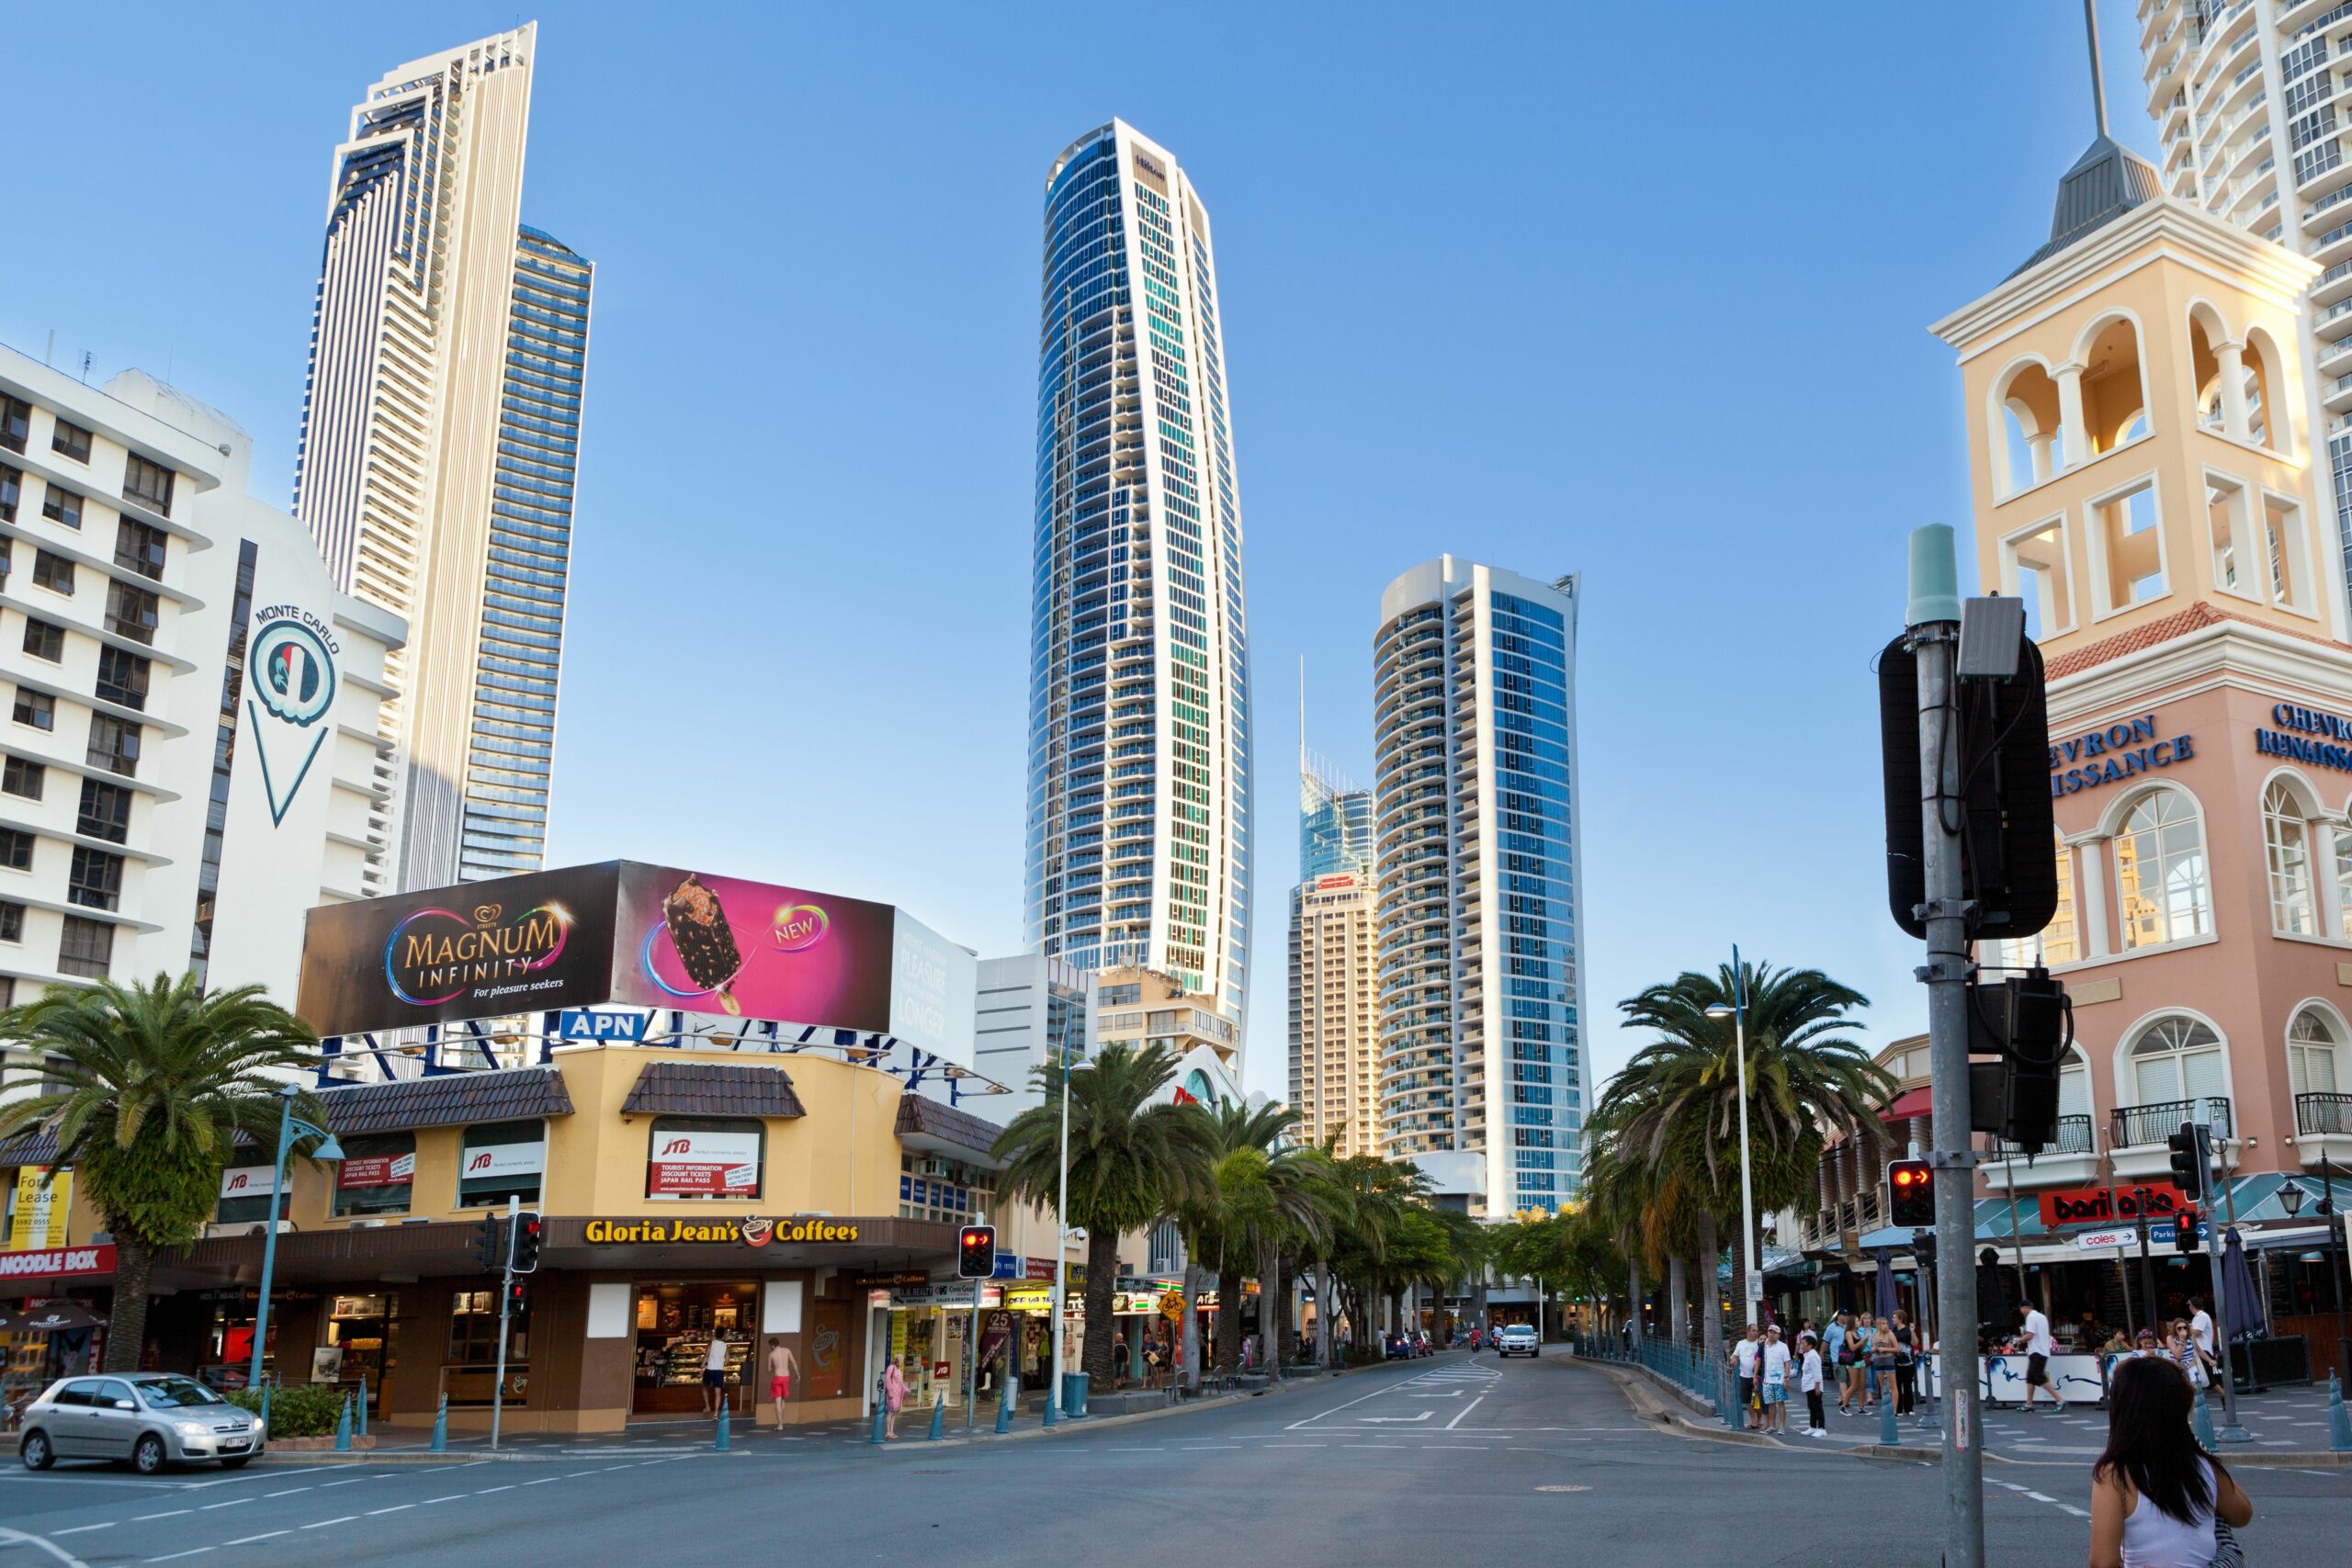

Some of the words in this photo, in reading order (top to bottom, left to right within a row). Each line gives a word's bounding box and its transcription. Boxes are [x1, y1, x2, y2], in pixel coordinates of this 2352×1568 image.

[255, 604, 300, 625] MONTE
[303, 612, 340, 654] CARLO
[2272, 703, 2352, 742] CHEVR
[2049, 715, 2154, 769] EVRON
[2254, 728, 2352, 771] RENAISS
[2051, 734, 2194, 797] ISSANCE
[404, 918, 556, 969] MAGNUM
[775, 917, 813, 944] NEW
[418, 956, 533, 988] INFINITY
[473, 987, 489, 998] For
[490, 983, 529, 997] pleasure
[530, 978, 564, 991] seekers
[570, 1014, 635, 1036] APN
[20, 1176, 44, 1188] For
[18, 1191, 59, 1203] Lease
[585, 1220, 665, 1242] Gloria
[670, 1220, 739, 1241] Jean's
[775, 1220, 859, 1241] Coffees
[2086, 1234, 2117, 1246] coles
[2154, 1230, 2177, 1239] Parki
[0, 1253, 63, 1275] NOODLE
[64, 1249, 99, 1271] BOX
